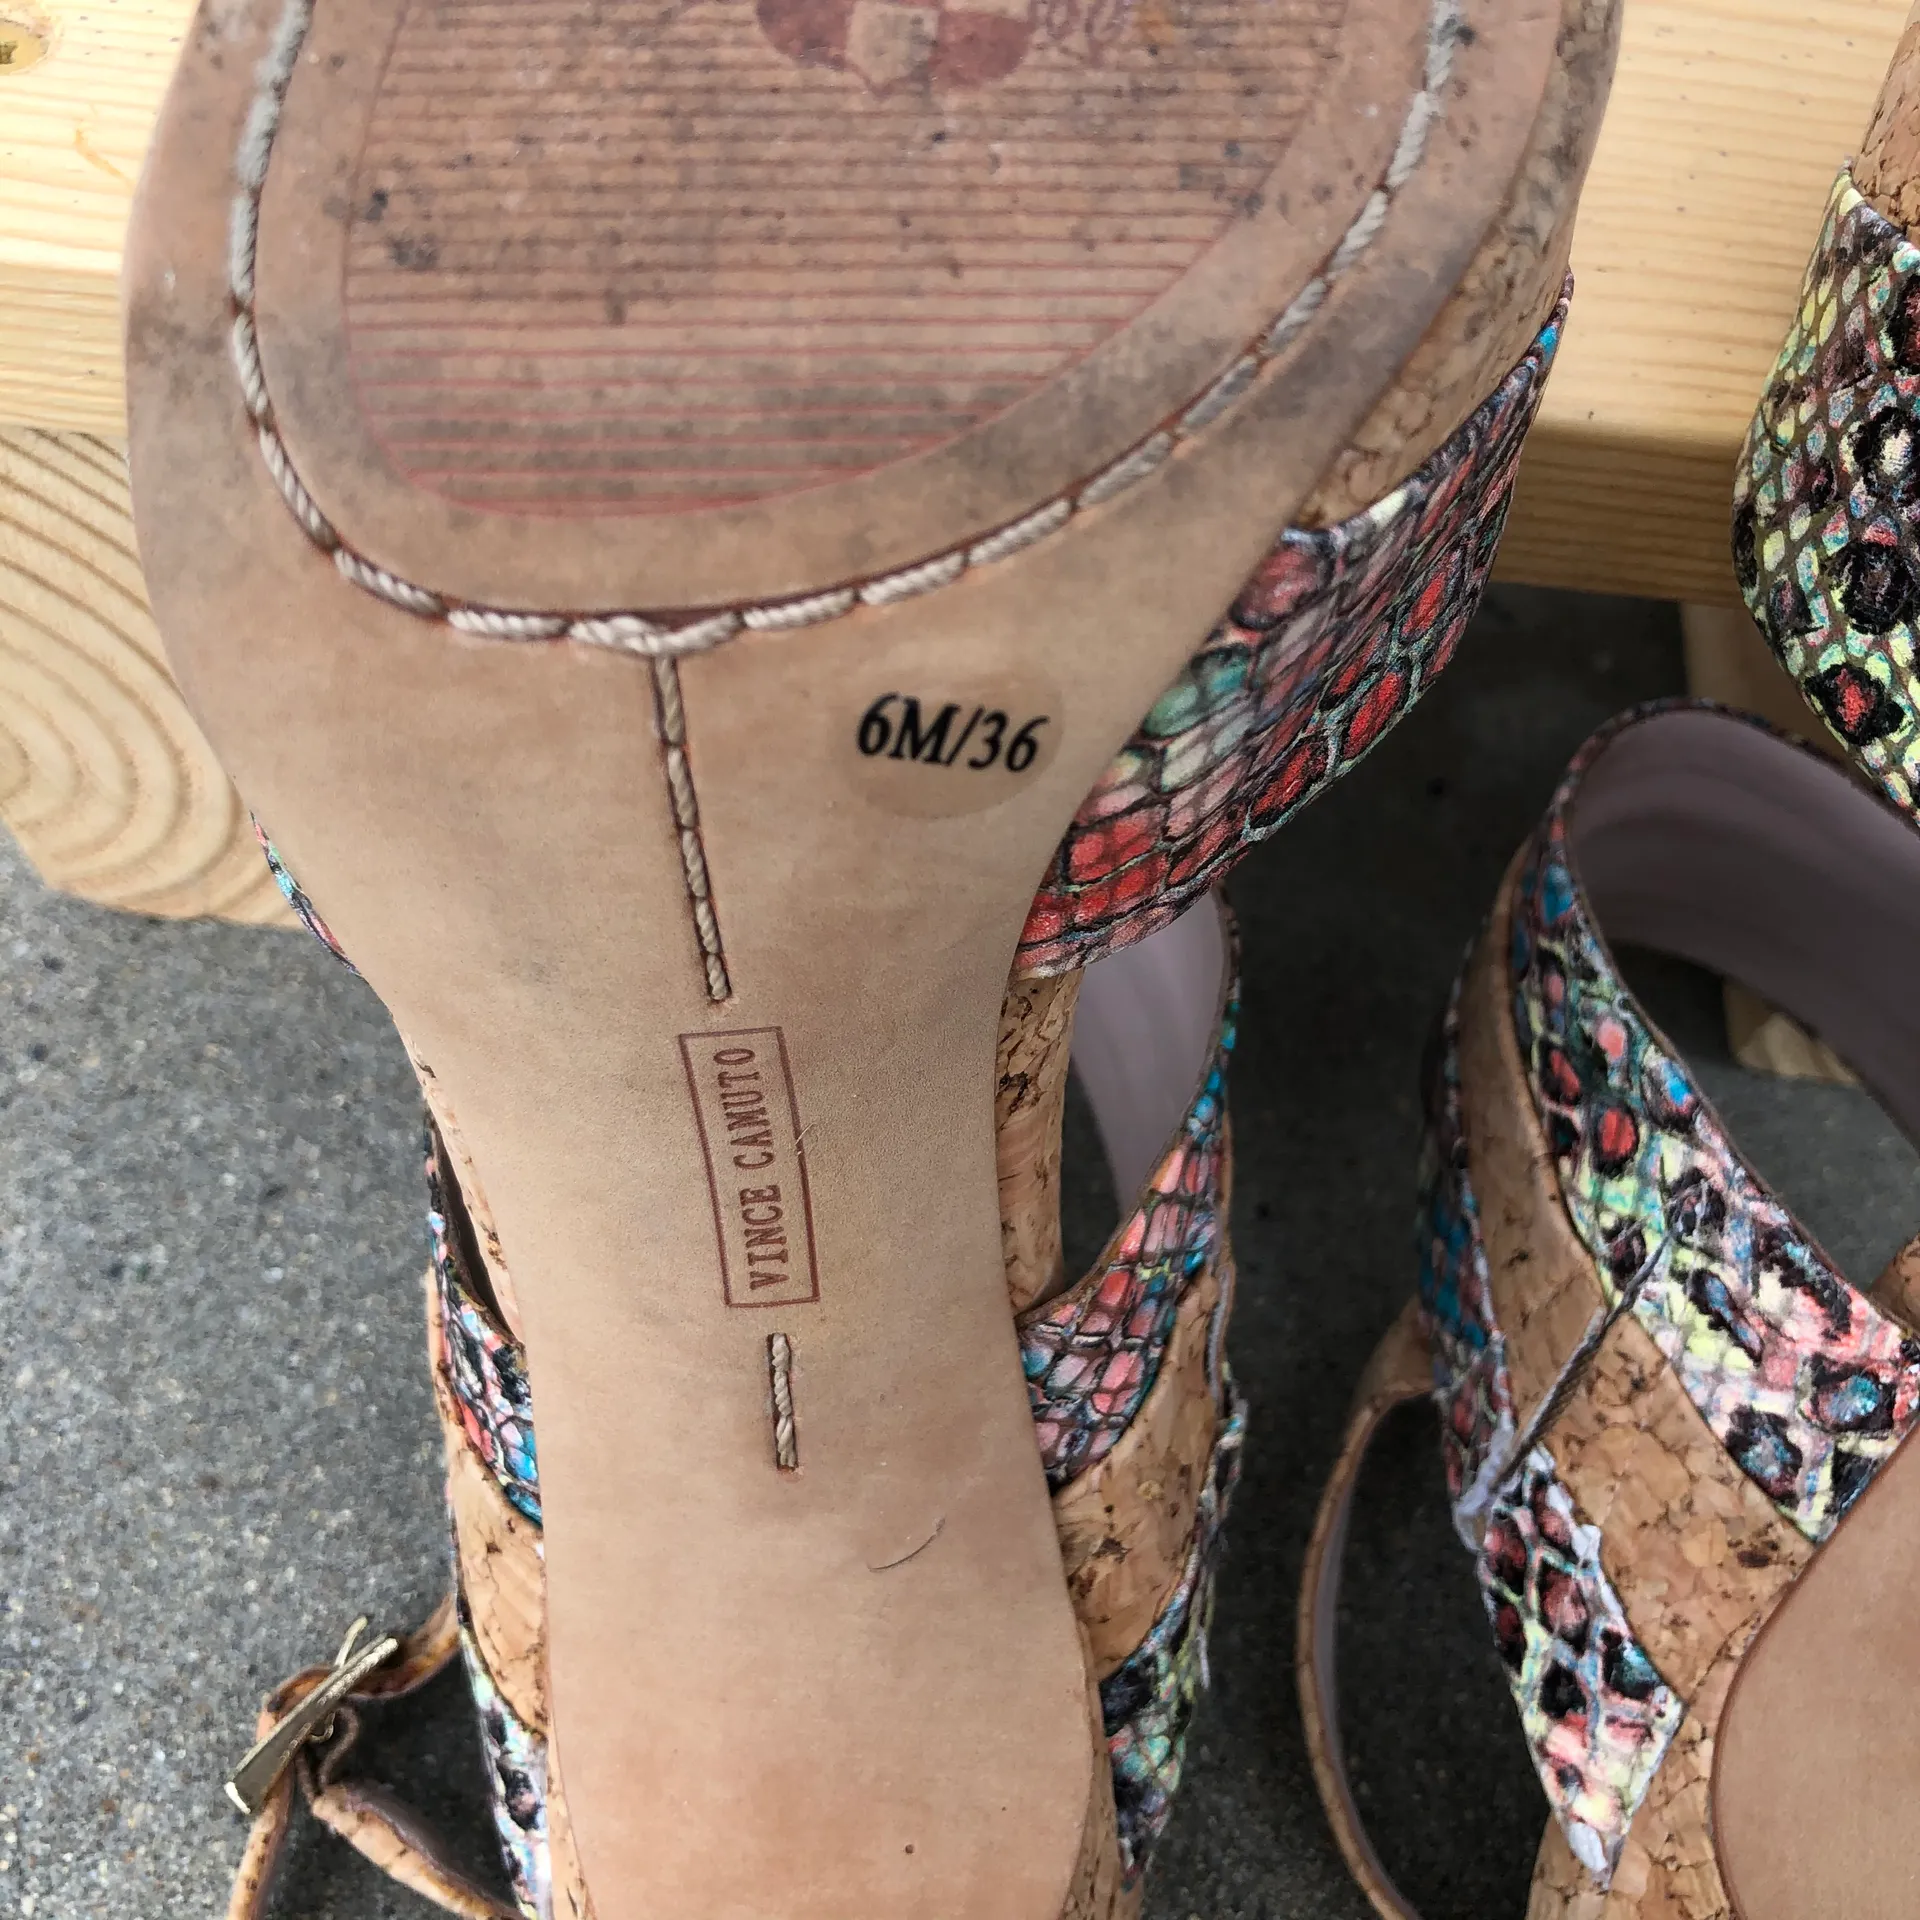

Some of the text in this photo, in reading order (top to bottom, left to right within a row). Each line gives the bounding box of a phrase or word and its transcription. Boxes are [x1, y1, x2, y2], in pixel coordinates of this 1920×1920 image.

[857, 691, 1050, 773] 6M/36
[712, 1047, 790, 1291] VINCE CAMUTO
